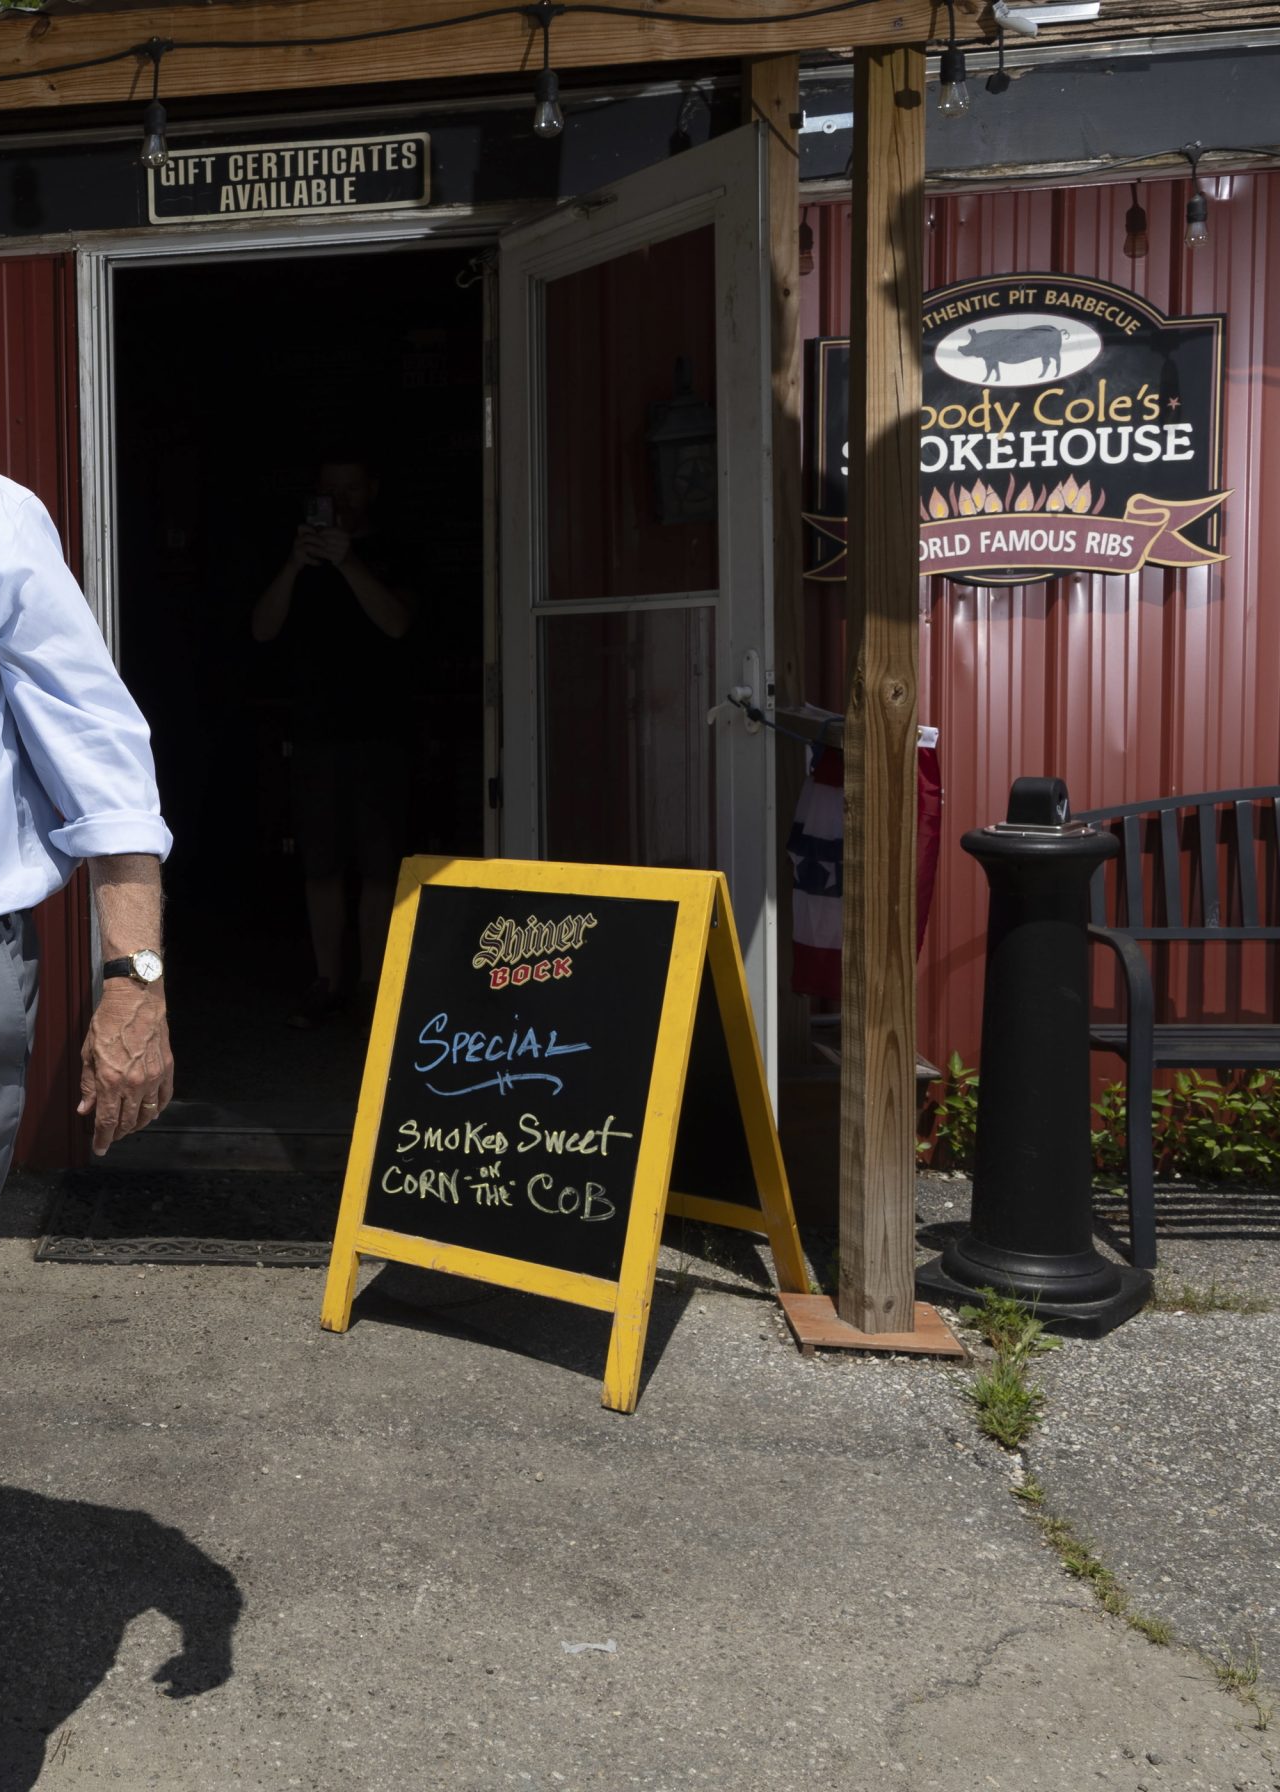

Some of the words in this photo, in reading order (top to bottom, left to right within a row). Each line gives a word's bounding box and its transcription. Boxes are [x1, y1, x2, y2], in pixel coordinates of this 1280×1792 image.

[161, 156, 216, 186] GIFT
[228, 141, 417, 182] CERTIFICATES
[220, 176, 357, 212] AVAILABLE
[921, 292, 1001, 333] THENTIC
[1009, 289, 1037, 305] PIT
[1044, 289, 1142, 336] BARBECUE
[921, 388, 1020, 439] oody
[1033, 379, 1160, 426] Cole's
[840, 422, 1195, 477] OKEHOUSE
[919, 534, 971, 561] ORLD
[980, 529, 1077, 553] FAMOUS
[1085, 531, 1135, 557] RIBS
[472, 912, 598, 969] Shiner
[490, 956, 572, 989] BOCK
